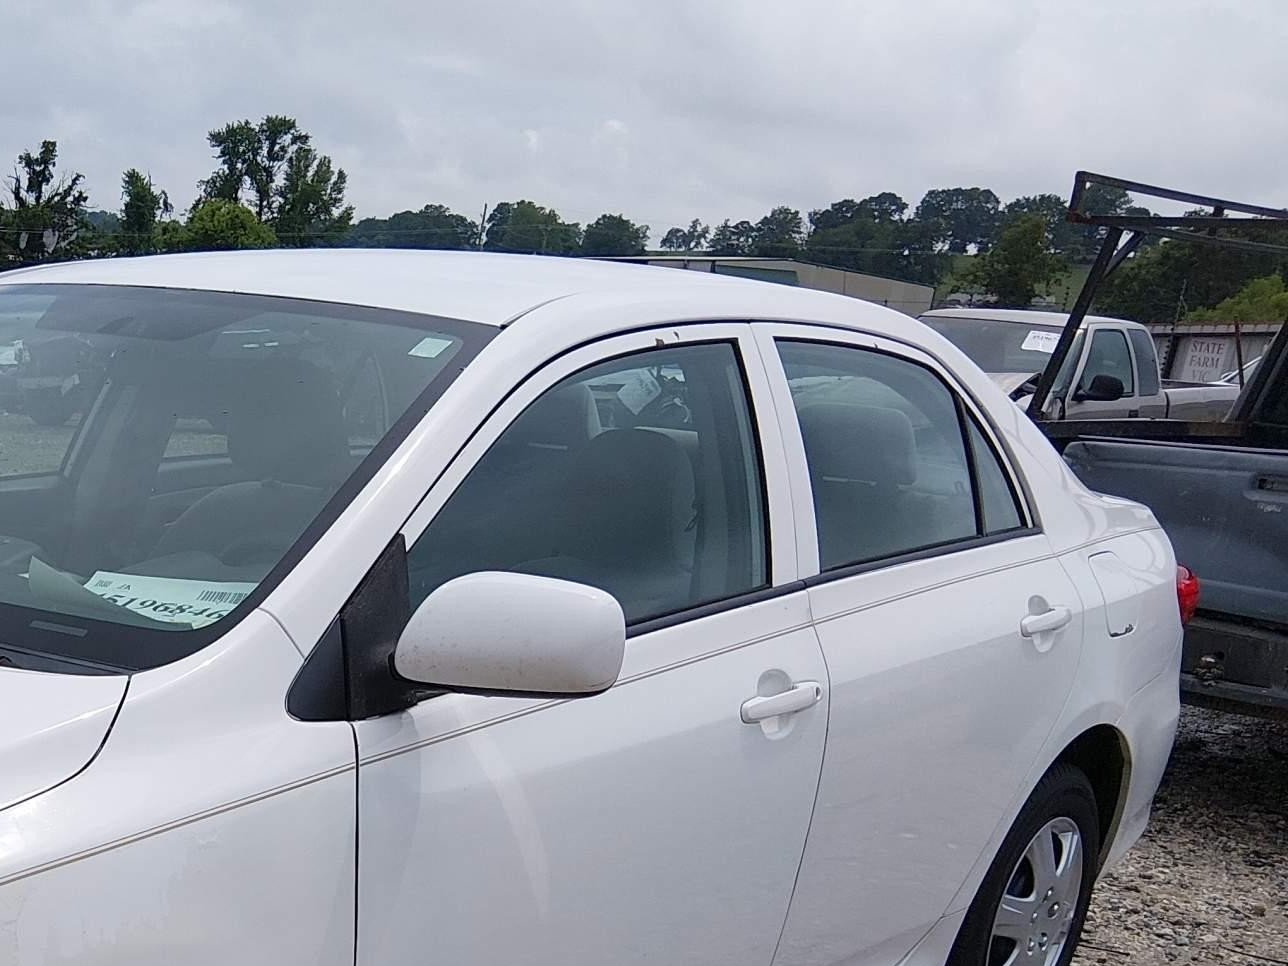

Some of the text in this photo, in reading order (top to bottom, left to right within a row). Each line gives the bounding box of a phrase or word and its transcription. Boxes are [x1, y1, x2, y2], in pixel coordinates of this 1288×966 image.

[1192, 340, 1224, 354] STATE
[1189, 355, 1219, 369] FARM
[98, 593, 230, 620] 5196846
